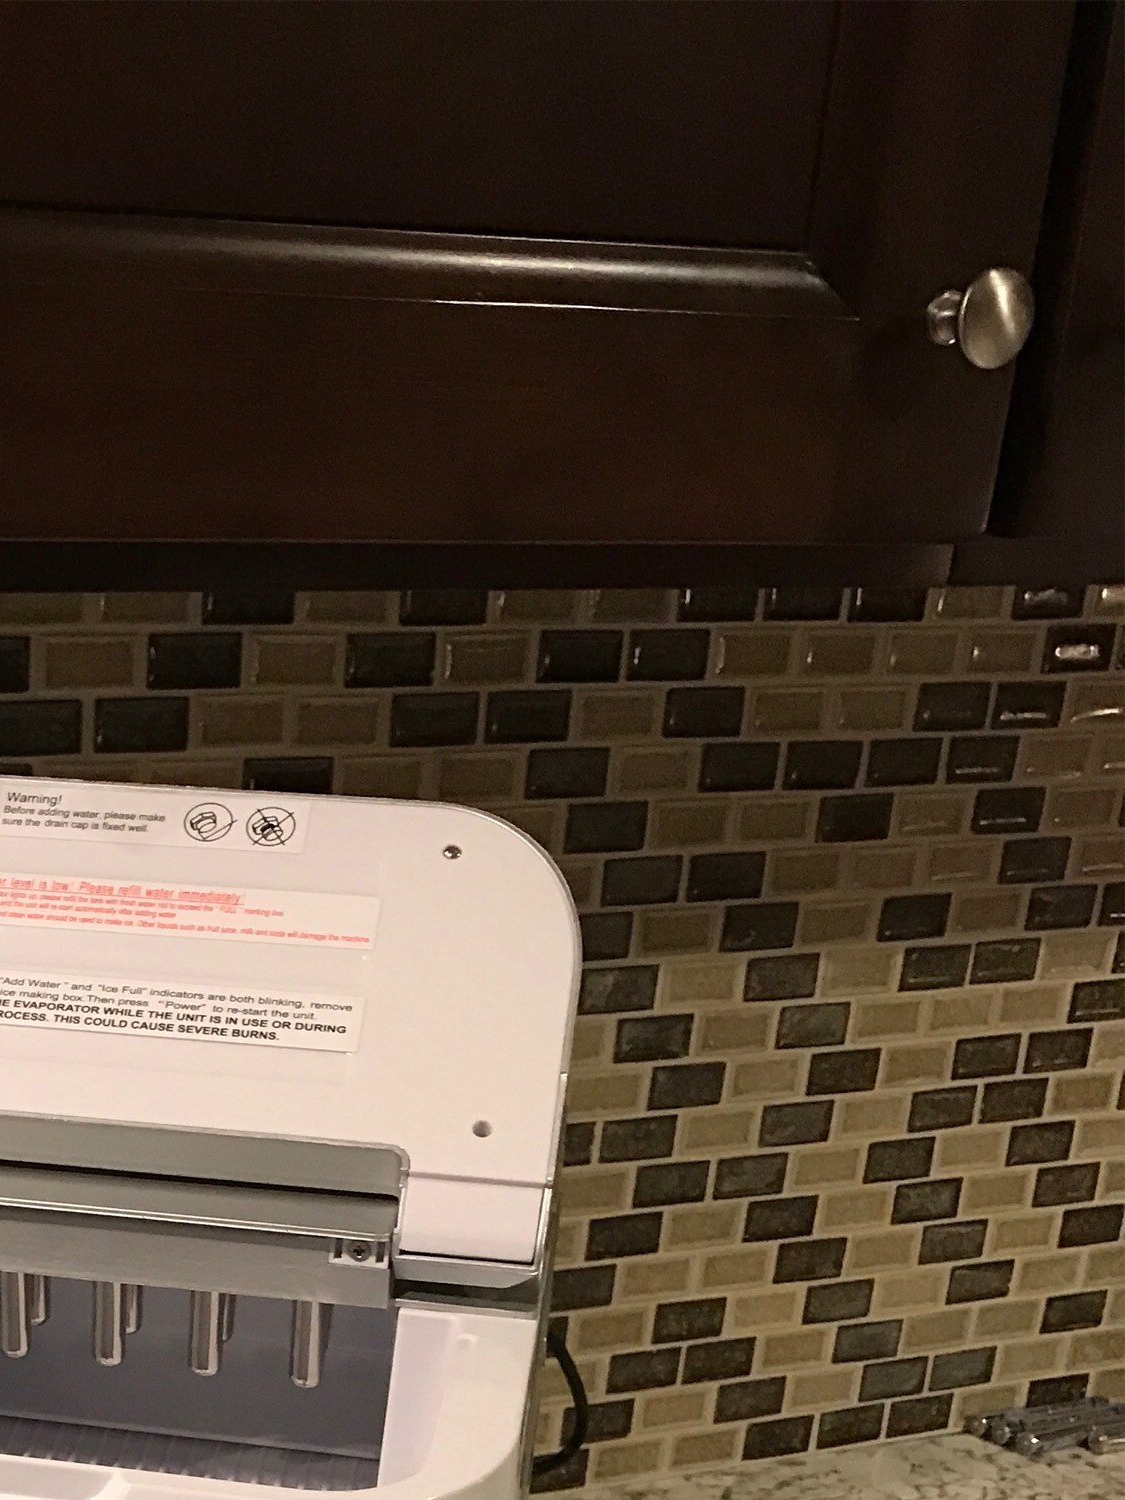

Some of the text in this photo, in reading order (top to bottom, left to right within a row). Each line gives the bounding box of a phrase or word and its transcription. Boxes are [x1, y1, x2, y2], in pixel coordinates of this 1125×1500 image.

[7, 792, 63, 807] Warning!
[25, 818, 41, 827] the
[11, 877, 35, 889] level
[39, 880, 47, 890] is
[80, 881, 114, 895] Please
[119, 884, 142, 896] refill
[145, 888, 174, 899] water
[0, 989, 16, 997] ice
[19, 990, 60, 1002] making
[87, 994, 115, 1004] Then
[118, 999, 149, 1007] press
[212, 1005, 223, 1013] to
[271, 1009, 289, 1018] the
[149, 988, 204, 1000] indicators
[229, 994, 254, 1003] both
[310, 1002, 353, 1012] remove
[13, 999, 101, 1015] EVAPORATOR
[103, 1006, 145, 1018] WHILE
[148, 1010, 174, 1020] THE
[176, 1013, 207, 1022] UNIT
[209, 1015, 222, 1024] IS
[225, 1016, 239, 1026] IN
[241, 1018, 269, 1028] USE
[271, 1020, 292, 1030] OR
[294, 1021, 347, 1034] DURING
[53, 1014, 81, 1024] THIS
[84, 1016, 128, 1028] COULD
[130, 1020, 175, 1032] CAUSE
[177, 1024, 229, 1036] SEVERE
[231, 1028, 280, 1041] BURNS.
